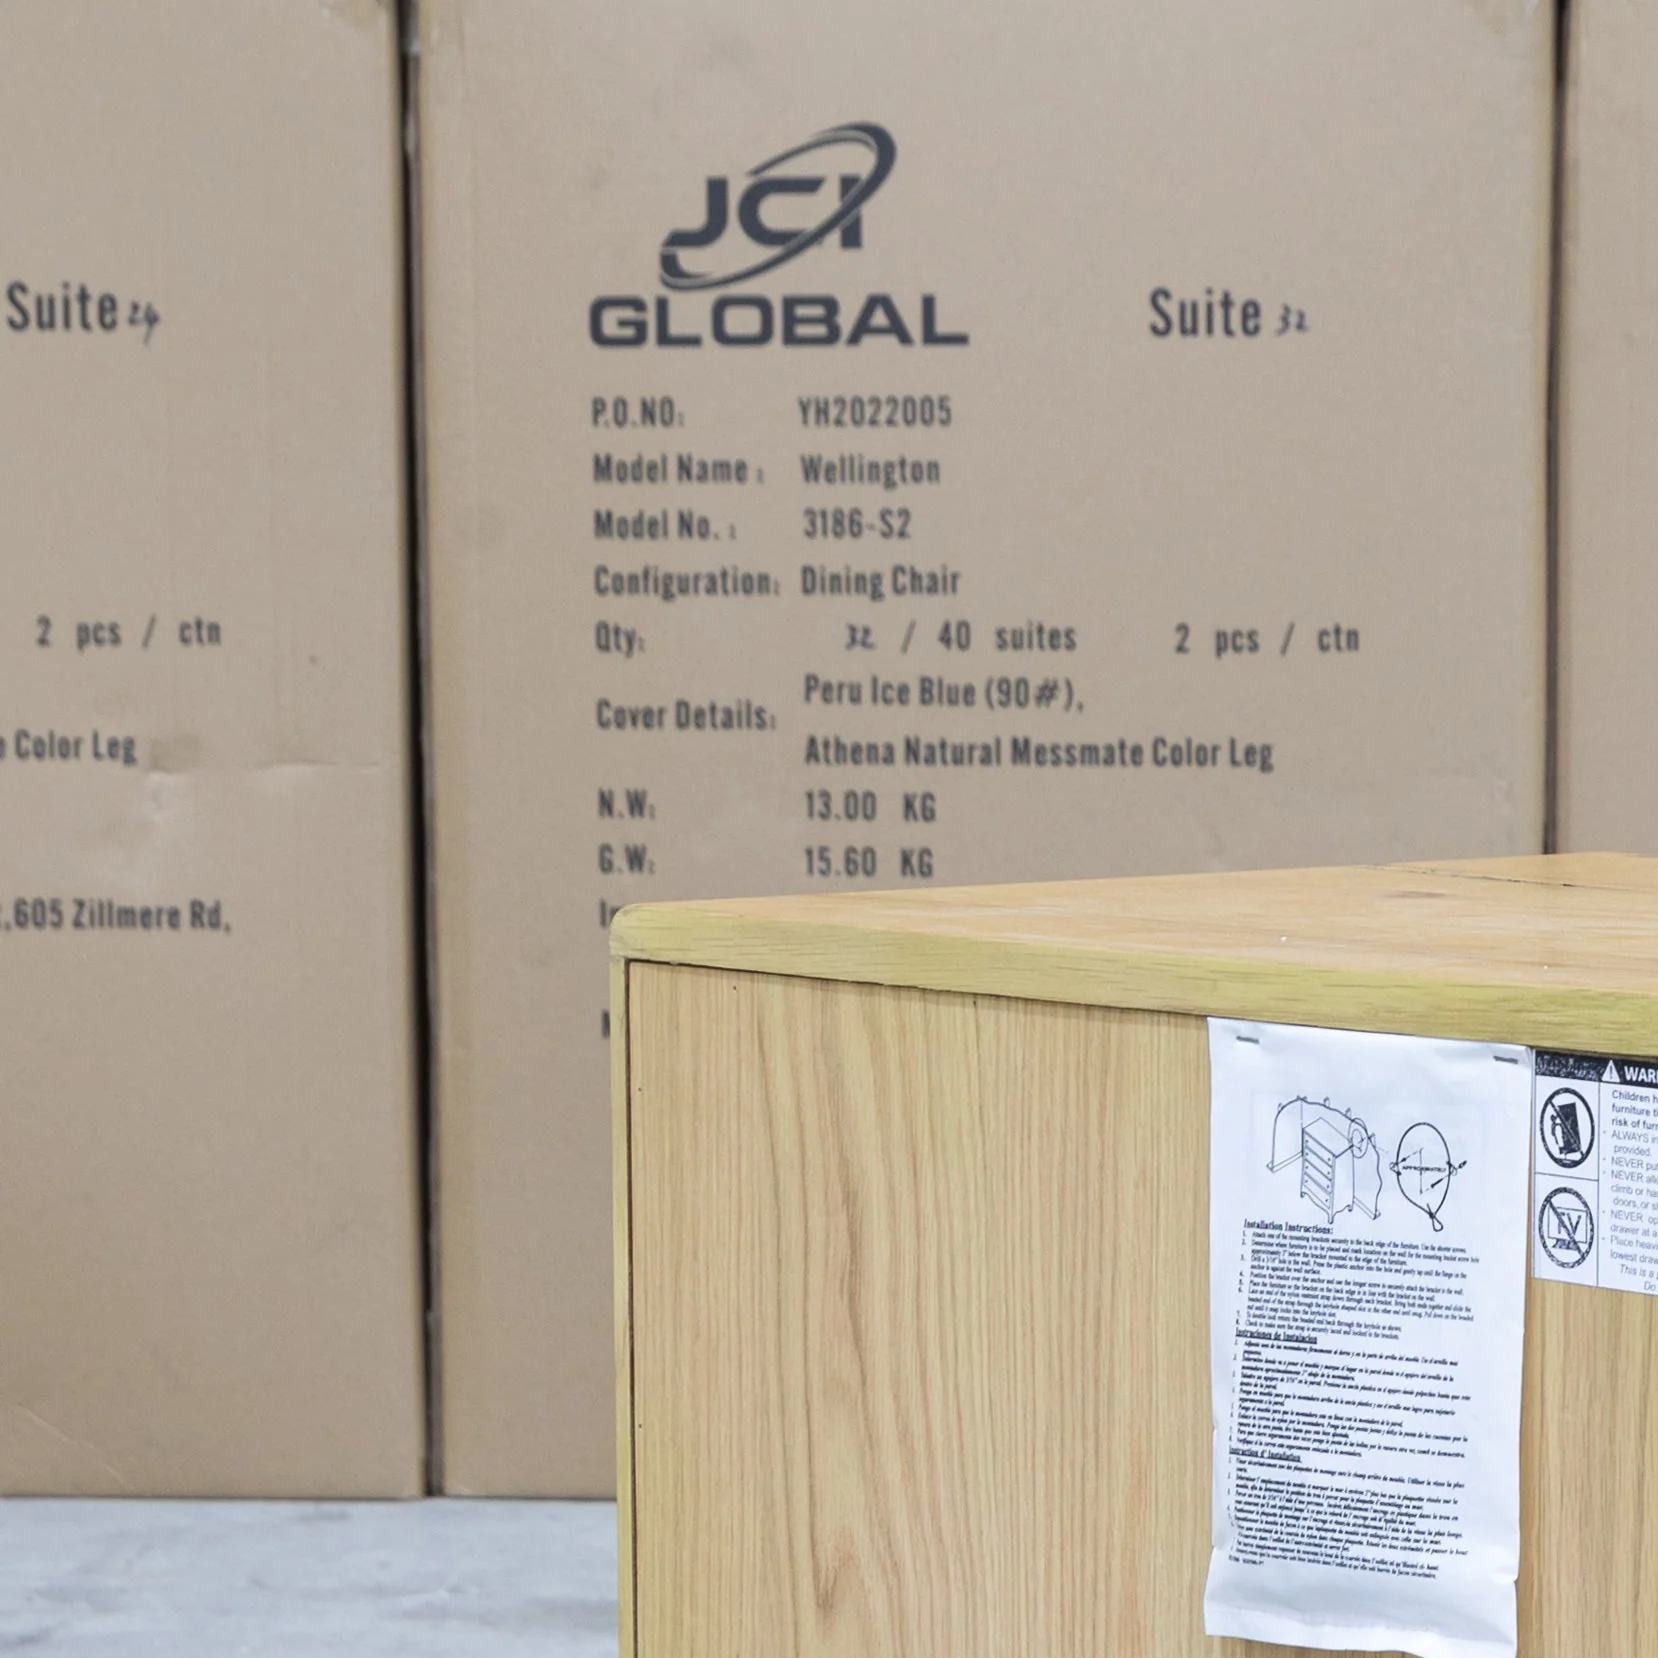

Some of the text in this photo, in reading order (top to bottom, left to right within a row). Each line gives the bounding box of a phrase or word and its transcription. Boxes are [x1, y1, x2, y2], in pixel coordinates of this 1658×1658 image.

[6, 281, 118, 332] Suite
[588, 294, 969, 348] GLOBAL
[1150, 287, 1261, 338] Suite
[798, 395, 952, 428] YH2022005
[593, 453, 940, 491] Model Wellington
[594, 507, 911, 540] Model 3186-S2
[594, 564, 960, 603] Configuration: Dining Chair
[36, 615, 221, 652] 2 pcs ctn
[595, 620, 1359, 659] Qty: 40 suites 2 pcs ctn
[804, 673, 976, 707] Peru Ice Blue
[596, 698, 776, 731] Cover Details:
[14, 729, 82, 761] Color
[92, 730, 138, 767] Leg
[804, 735, 1274, 774] Athena Natural Messmate Color Leg
[805, 789, 936, 823] 13.00 KG
[805, 845, 933, 878] 15.60 KG
[71, 898, 231, 933] Zillmere Rd,
[1612, 1090, 1650, 1102] Children
[1612, 1103, 1650, 1116] furniture
[1612, 1117, 1628, 1126] risk
[1612, 1130, 1649, 1143] ALWAYS
[1611, 1157, 1643, 1168] NEVER
[1646, 1161, 1658, 1172] put
[1611, 1170, 1643, 1183] NEVER
[1611, 1184, 1633, 1194] climb
[1635, 1188, 1644, 1196] or
[1611, 1210, 1643, 1222] NEVER
[1611, 1224, 1649, 1236] drawer at
[1610, 1250, 1637, 1262] lowest
[1611, 1235, 1633, 1247] Place
[1620, 1264, 1637, 1275] This
[1639, 1267, 1646, 1276] is
[1644, 1281, 1656, 1291] Do
